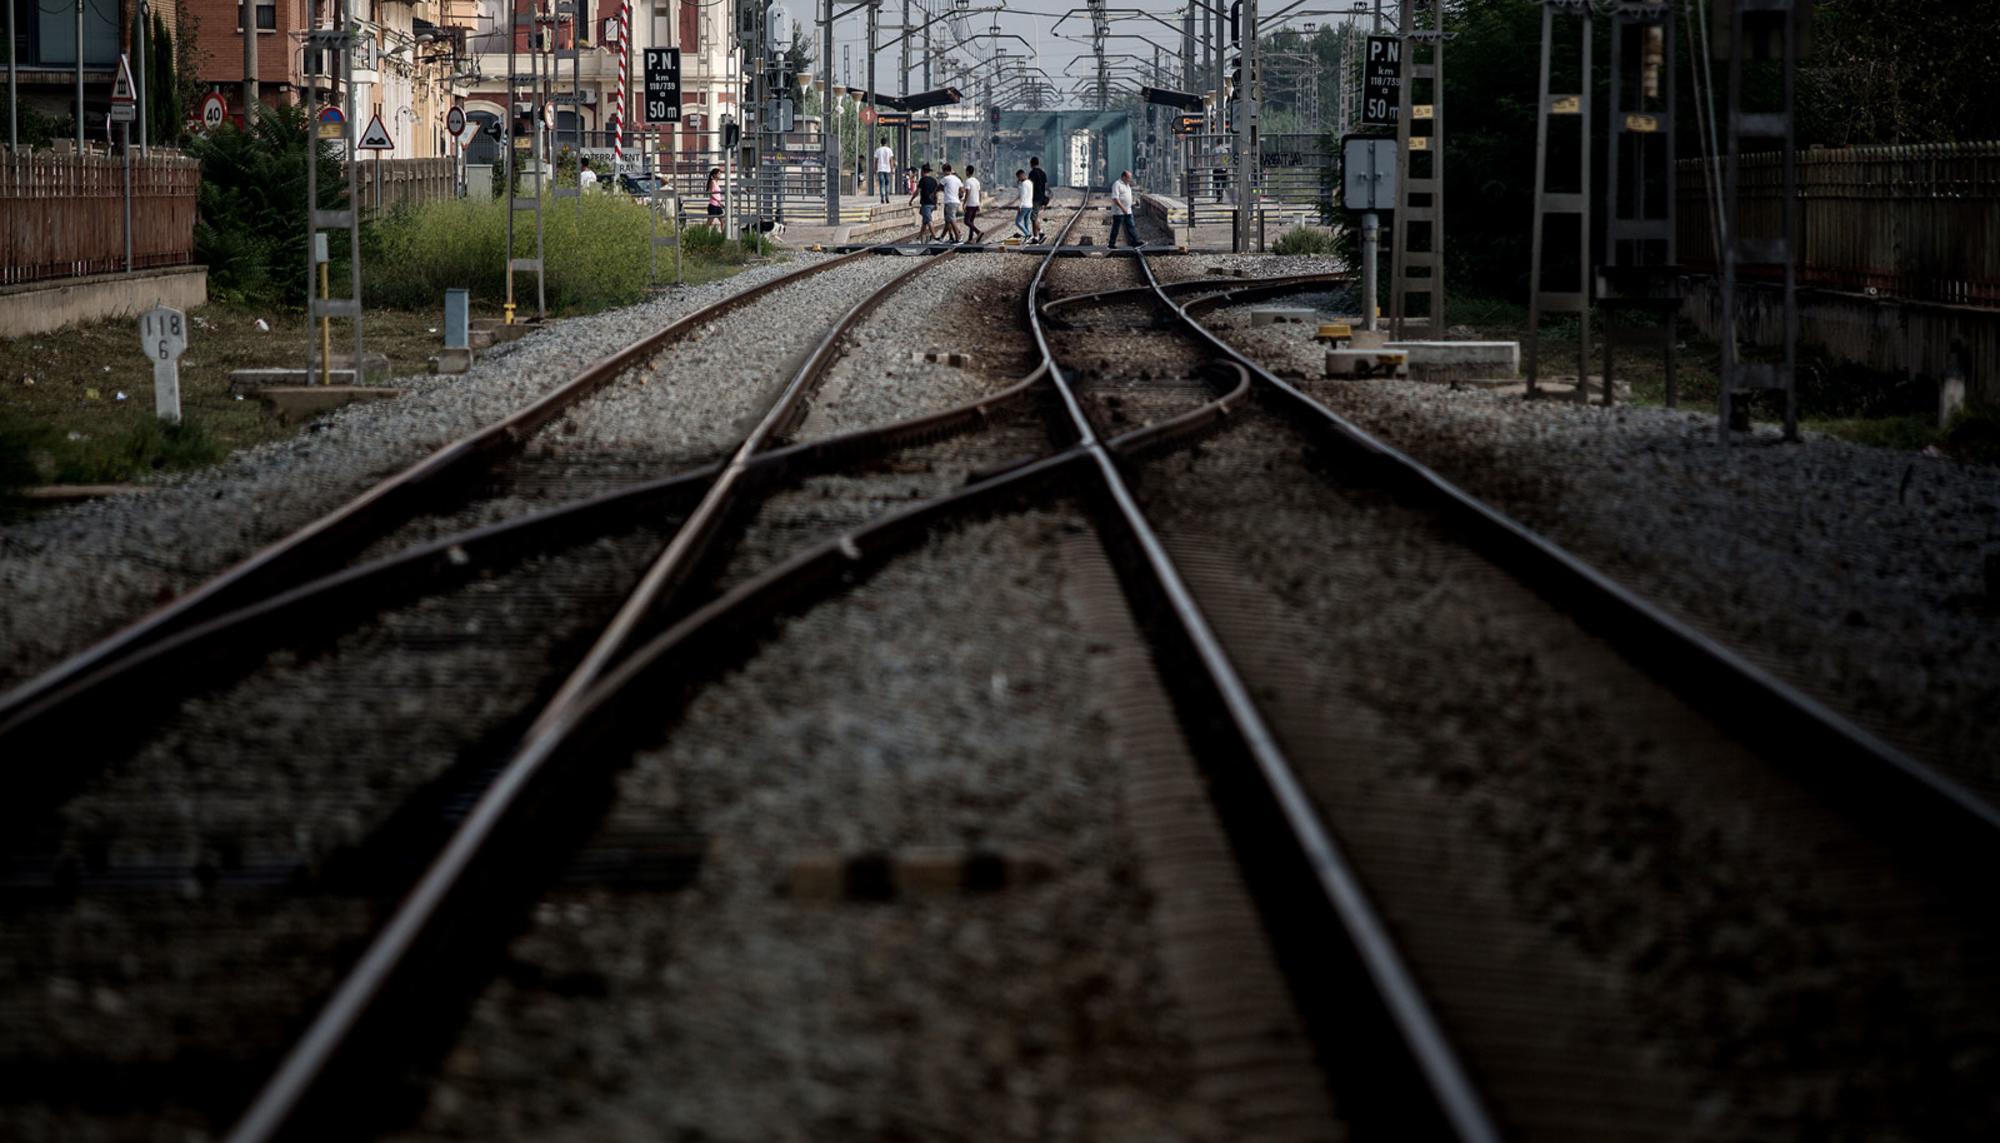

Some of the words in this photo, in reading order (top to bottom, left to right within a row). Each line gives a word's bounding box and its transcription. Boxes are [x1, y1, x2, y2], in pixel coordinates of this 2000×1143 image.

[648, 52, 676, 70] P.N.
[655, 73, 669, 81] km
[1378, 65, 1394, 76] km
[206, 107, 220, 122] 40
[649, 101, 665, 118] 50
[667, 106, 677, 118] m
[865, 110, 871, 121] 1
[1368, 98, 1386, 119] 50
[1388, 105, 1400, 120] m
[147, 314, 180, 336] 118
[159, 339, 169, 360] 6
